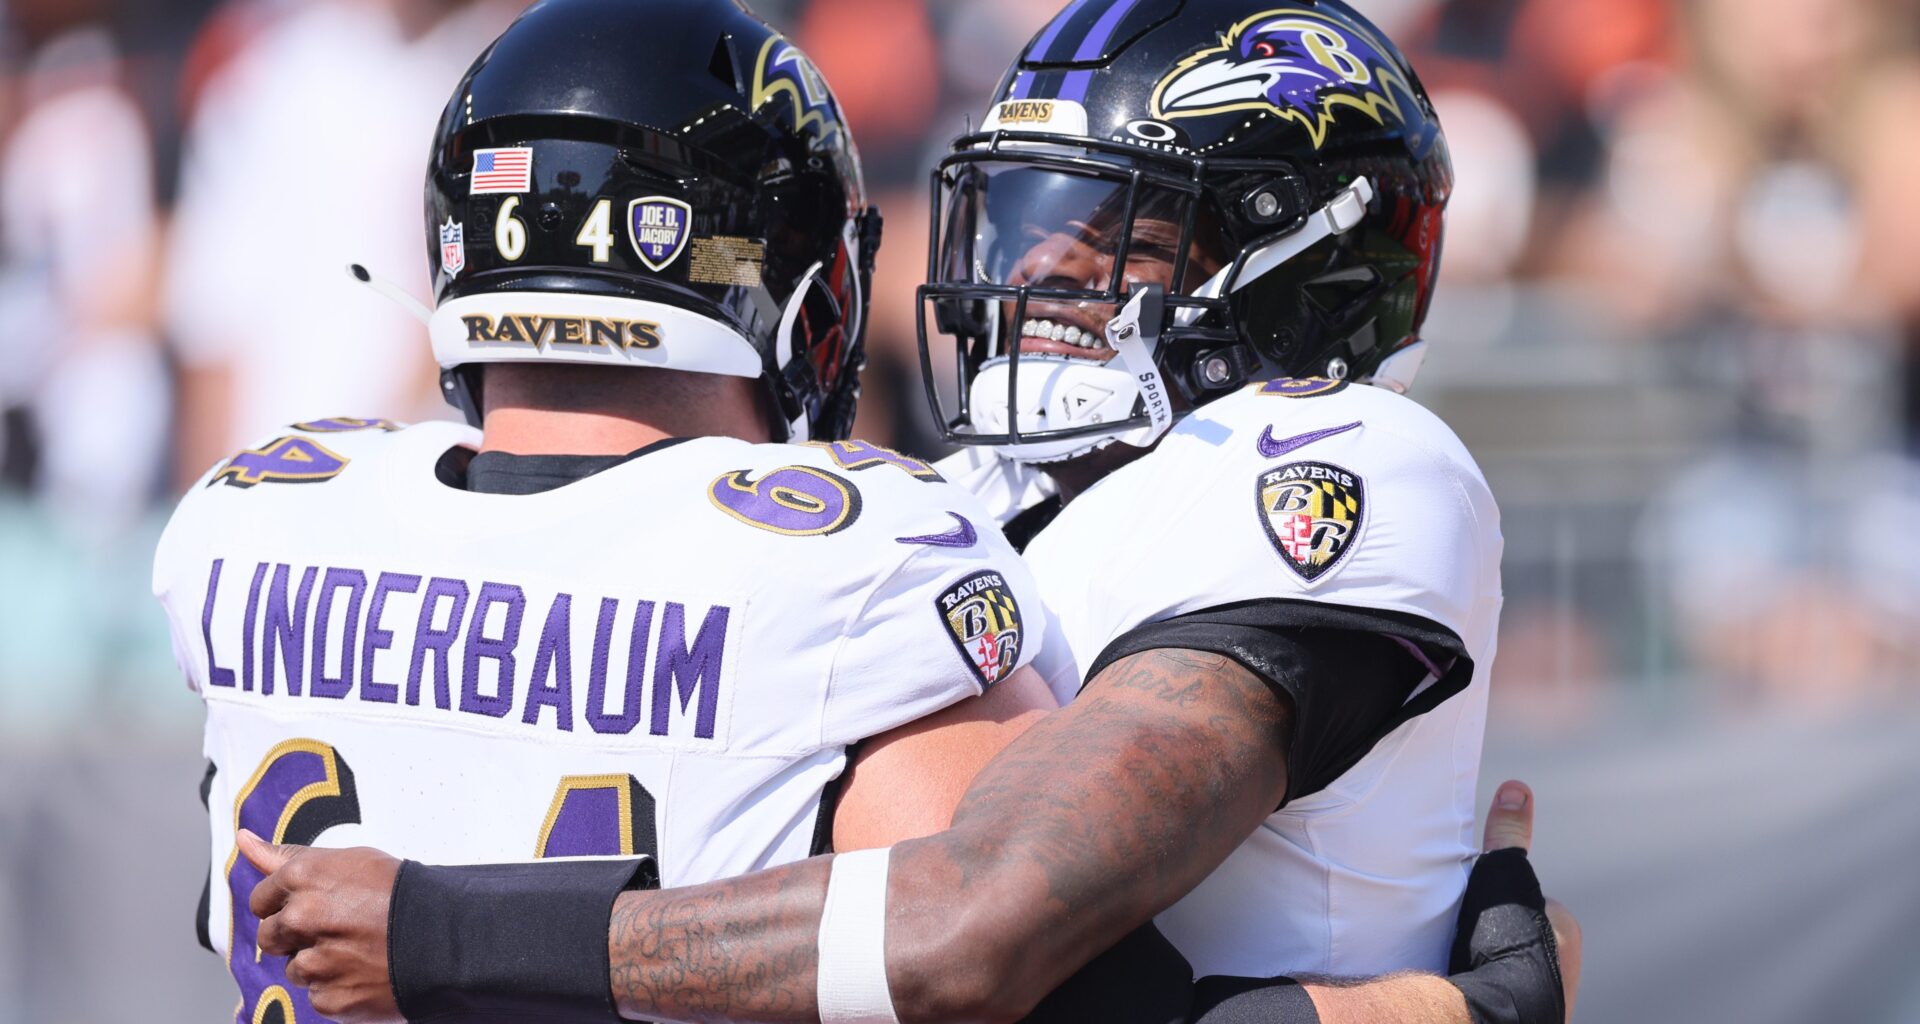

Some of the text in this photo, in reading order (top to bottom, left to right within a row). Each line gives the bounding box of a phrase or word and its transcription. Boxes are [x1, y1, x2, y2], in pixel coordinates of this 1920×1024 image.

[999, 101, 1054, 123] RAVENS
[640, 205, 679, 228] JOE D.
[495, 196, 526, 261] 6
[576, 199, 614, 263] 4
[639, 228, 678, 245] JACOBY
[444, 244, 462, 268] NFL
[652, 244, 664, 256] 12
[461, 313, 661, 351] RAVENS
[1138, 371, 1164, 416] SPORT
[1263, 465, 1354, 488] RAVENS
[942, 574, 1003, 611] RAVENS
[202, 558, 730, 739] LINDERBAUM
